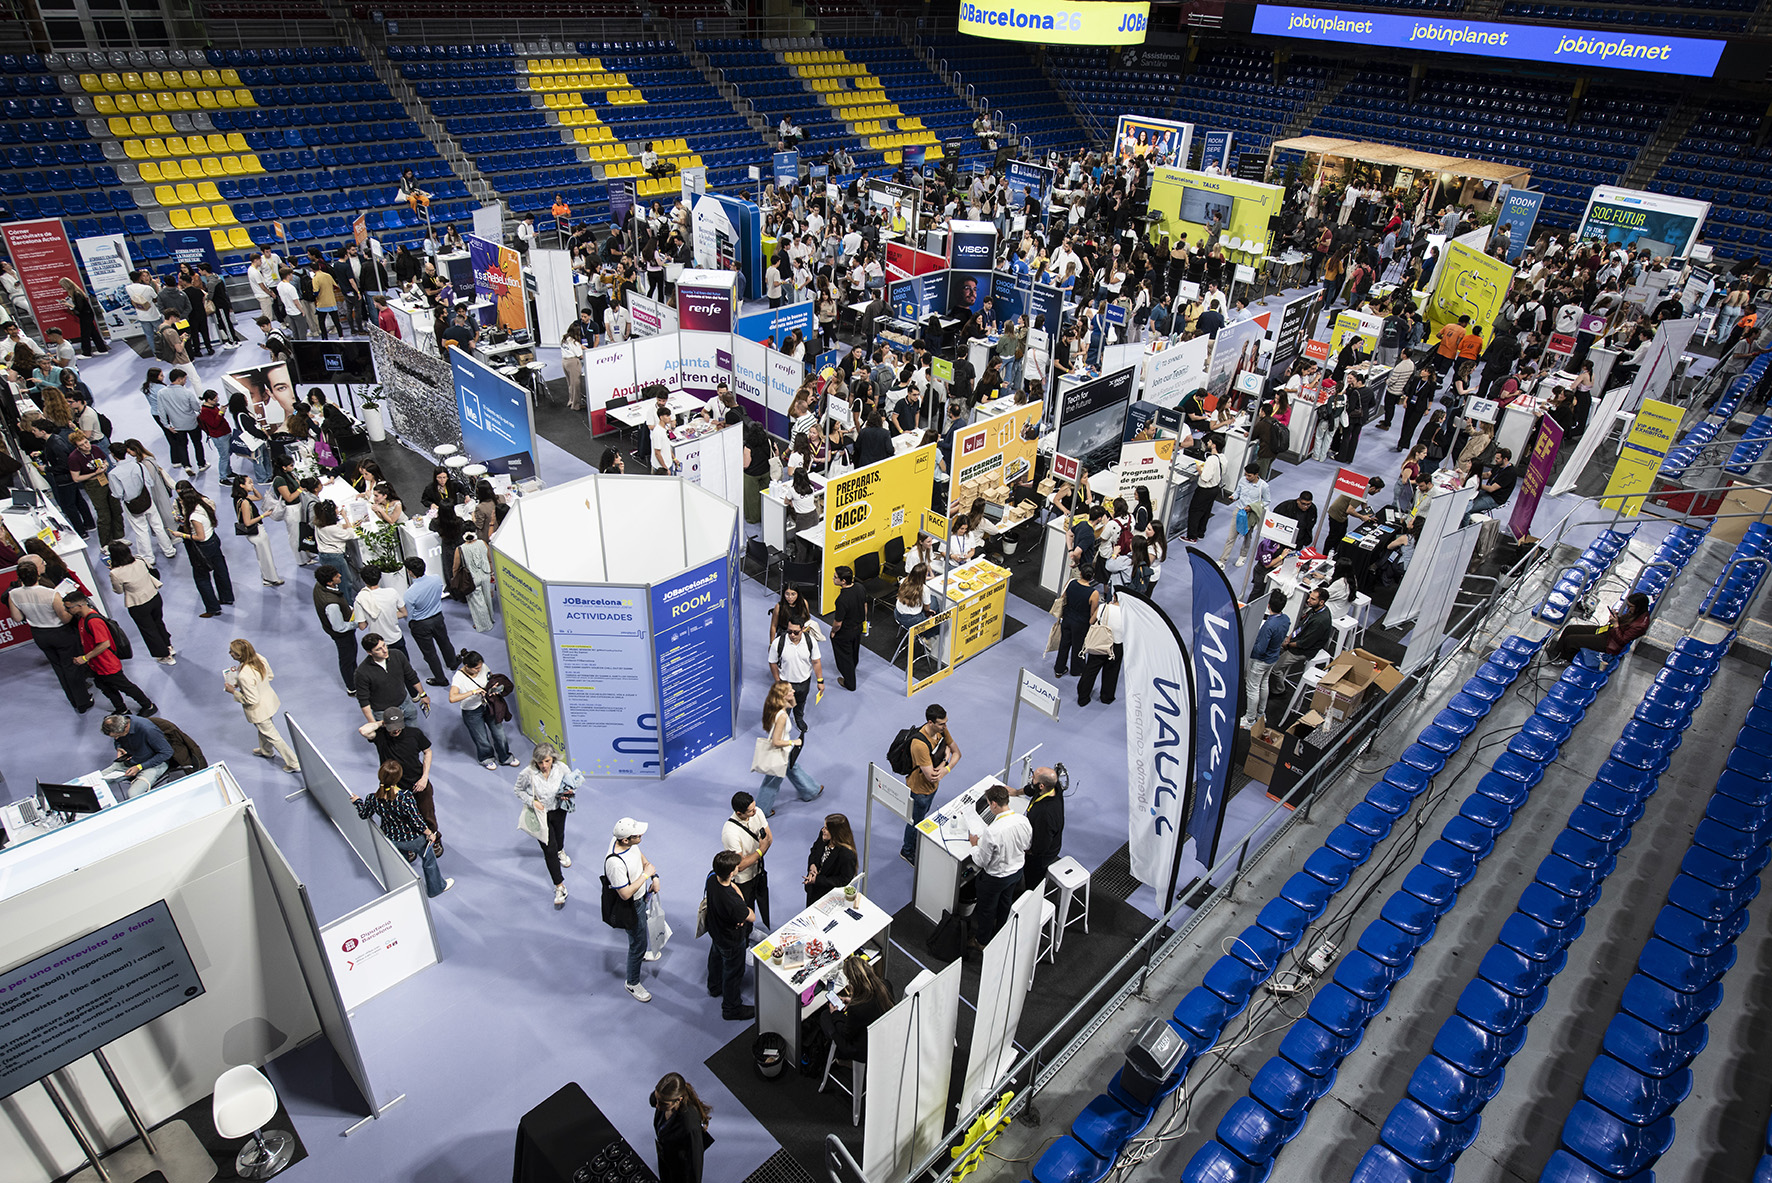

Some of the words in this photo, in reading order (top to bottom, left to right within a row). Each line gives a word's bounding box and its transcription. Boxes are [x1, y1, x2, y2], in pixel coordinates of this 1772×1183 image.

[960, 4, 1082, 32] JOBarcelona26
[1288, 12, 1373, 34] jobinplanet
[1410, 23, 1509, 46] jobinplanet
[1141, 50, 1180, 61] Assistència
[1554, 35, 1672, 61] jobinplanet
[1202, 181, 1220, 190] TALKS
[1509, 196, 1537, 208] ROOM
[1510, 206, 1529, 216] SOC
[1591, 205, 1613, 220] SOC
[1611, 209, 1646, 226] FUTUR
[12, 237, 42, 246] Barcelona
[688, 303, 722, 317] renfe
[1308, 344, 1323, 354] ABA
[596, 352, 624, 365] renfe
[736, 363, 754, 379] tren
[774, 361, 796, 375] renfe
[668, 371, 679, 384] al
[682, 371, 708, 383] tren
[711, 373, 731, 384] del
[1152, 375, 1163, 388] Join
[1162, 373, 1172, 381] our
[1067, 394, 1078, 404] Tech
[1078, 391, 1089, 401] for
[830, 403, 847, 415] odoo
[1066, 404, 1076, 413] the
[1075, 398, 1092, 411] future
[1472, 400, 1493, 413] EF
[466, 406, 478, 421] Me
[1635, 427, 1669, 440] EXHIBITORS
[1646, 425, 1663, 434] AREA
[1535, 431, 1554, 460] EF
[916, 455, 928, 464] RACC
[960, 466, 973, 478] FES
[972, 454, 1003, 471] CARRERA
[1121, 468, 1159, 477] Programa
[1129, 474, 1164, 483] graduats
[836, 470, 882, 496] PREPARATS,
[835, 486, 875, 508] LLESTOS...
[834, 504, 868, 531] RACC!
[928, 514, 944, 528] RACC
[1261, 553, 1272, 563] 23
[663, 572, 718, 601] JOBarcelona26
[562, 597, 633, 606] JOBarcelona26
[671, 592, 711, 618] ROOM
[566, 612, 633, 621] ACTIVIDADES
[934, 611, 952, 625] RACC!
[360, 920, 392, 939] Diputació
[362, 925, 393, 944] Barcelona
[8, 977, 28, 991] per
[29, 967, 52, 980] una
[53, 939, 108, 968] entrevista
[112, 931, 125, 940] de
[128, 917, 155, 932] feina
[20, 990, 32, 998] de
[32, 973, 66, 992] treball)
[71, 946, 123, 975] proporciona
[11, 999, 57, 1023] entrevista
[57, 992, 69, 1001] de
[70, 983, 89, 995] (lloc
[90, 977, 101, 985] de
[102, 960, 133, 979] treball)
[137, 946, 165, 961] avalua
[0, 993, 43, 1015] espostes.
[9, 1032, 30, 1045] meu
[31, 1016, 62, 1034] discurs
[64, 1010, 75, 1018] de
[75, 984, 125, 1013] presentació
[126, 966, 161, 988] personal
[161, 960, 175, 970] per
[82, 1001, 121, 1024] conflictes)
[125, 987, 151, 1002] avalua
[159, 973, 179, 985] meva
[78, 1029, 91, 1039] per
[97, 1017, 114, 1028] (lloc
[125, 997, 152, 1013] treball)
[155, 984, 180, 998] avalua
[6, 1033, 42, 1054] millores
[43, 1025, 58, 1034] em
[58, 996, 112, 1027] suggereixes?
[1157, 1035, 1170, 1050] PUSH
